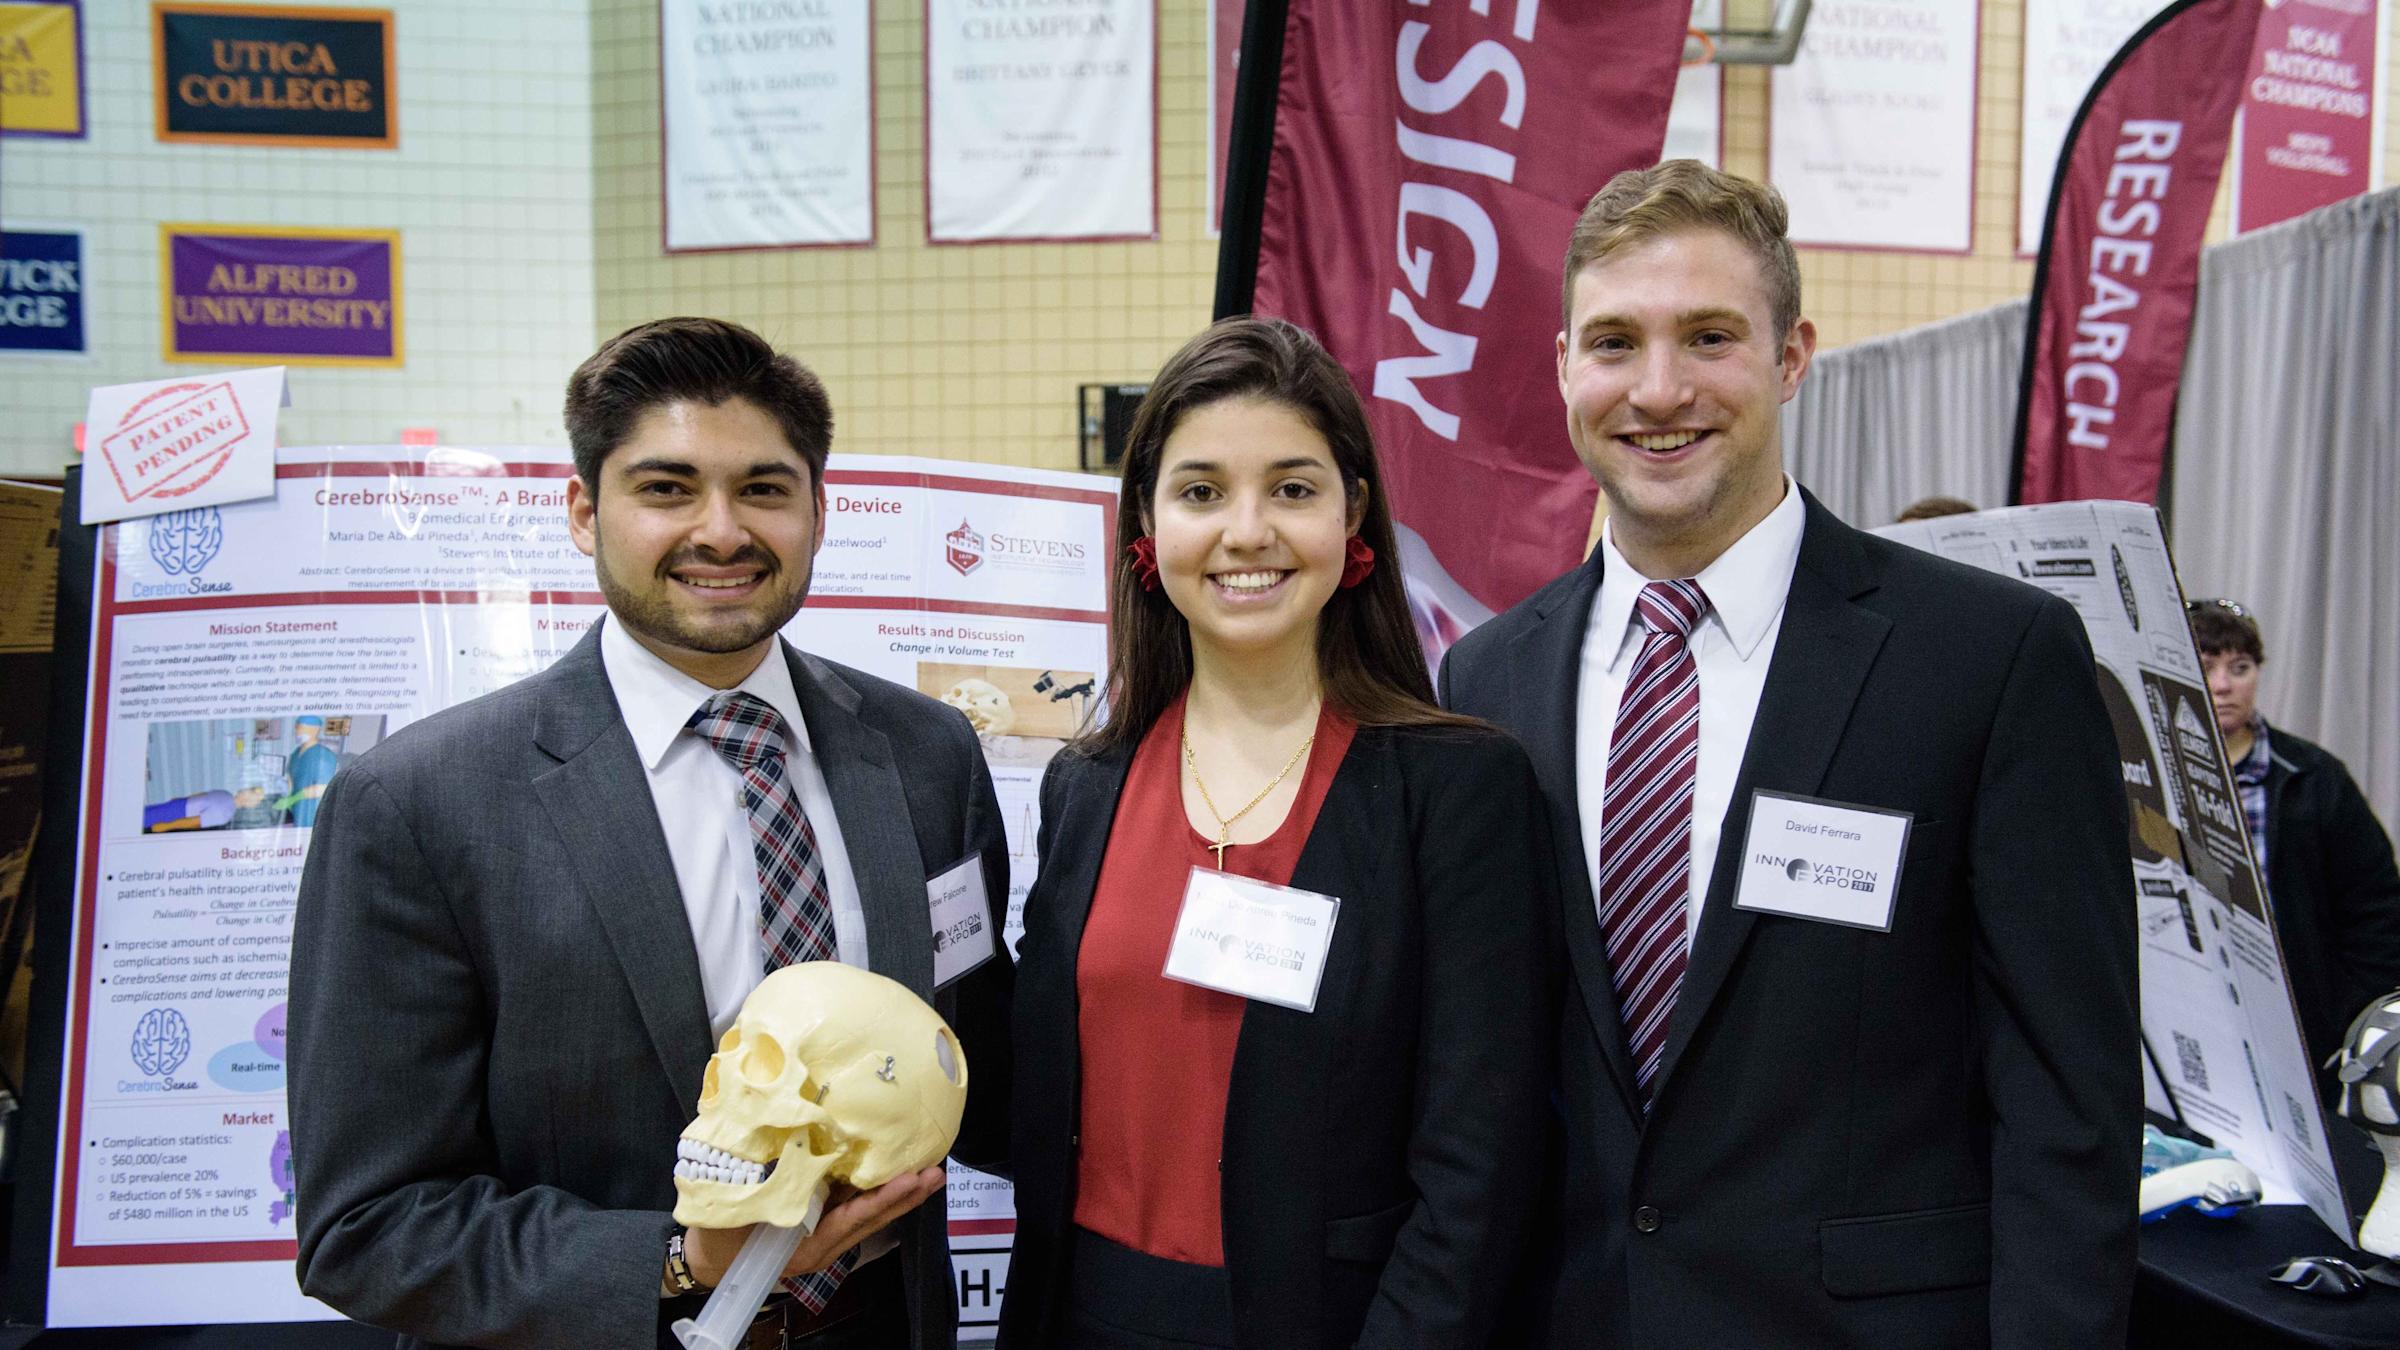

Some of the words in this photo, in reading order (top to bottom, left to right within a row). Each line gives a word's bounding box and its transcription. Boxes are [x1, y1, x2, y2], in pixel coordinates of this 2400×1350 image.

[961, 14, 1116, 41] CHAMPION
[693, 26, 838, 57] CHAMPION
[212, 40, 336, 75] UTICA
[2265, 51, 2361, 89] NATIONAL
[178, 75, 373, 112] COLLEGE
[2252, 76, 2369, 118] CHAMPIONS
[207, 262, 357, 295] ALFRED
[2064, 120, 2183, 450] RESEARCH
[174, 297, 392, 330] UNIVERSITY
[127, 397, 221, 452] PATENT
[135, 414, 235, 477] PENDING
[496, 490, 509, 505] A
[836, 497, 902, 513] Device
[408, 512, 485, 524] Bomedical
[329, 531, 364, 541] Maria
[368, 531, 384, 541] De
[547, 548, 561, 558] of
[991, 533, 1086, 559] STEVENS
[890, 574, 912, 582] time
[132, 577, 233, 598] CerebroSense
[809, 584, 864, 593] mplications
[209, 623, 261, 636] Mission
[265, 621, 338, 634] Statement
[537, 618, 592, 631] Materia
[878, 624, 926, 636] Results
[930, 627, 954, 638] and
[958, 627, 1025, 643] Discussion
[161, 643, 183, 653] open
[319, 636, 336, 644] and
[889, 642, 931, 654] Change
[934, 644, 944, 654] in
[948, 645, 989, 657] Volume
[993, 648, 1015, 658] Test
[155, 655, 191, 665] cerebral
[192, 653, 237, 664] pulsatility
[290, 649, 335, 658] determine
[336, 649, 356, 657] how
[357, 649, 372, 657] the
[374, 648, 396, 657] brain
[279, 663, 293, 671] the
[295, 662, 356, 671] measurement
[368, 662, 398, 670] limited
[120, 684, 165, 695] qualitative
[167, 682, 209, 691] technique
[210, 680, 235, 688] which
[291, 676, 337, 685] inaccurate
[339, 675, 407, 684] determinations
[161, 694, 218, 704] complications
[249, 691, 266, 699] and
[290, 689, 304, 697] the
[344, 688, 401, 698] Recognizing
[402, 688, 417, 696] the
[304, 702, 342, 711] solution
[356, 702, 372, 710] this
[2121, 758, 2152, 786] oard
[1785, 820, 1817, 835] David
[1820, 825, 1861, 841] Ferrara
[221, 845, 303, 861] Background
[118, 869, 165, 882] Cerebral
[168, 867, 222, 882] pulsatility
[225, 867, 233, 877] is
[237, 866, 263, 877] used
[169, 885, 203, 897] health
[206, 882, 297, 896] intraoperatively
[943, 885, 967, 902] Falcone
[1852, 881, 1875, 893] 2017
[210, 900, 245, 911] Change
[260, 898, 296, 908] Cerebra
[152, 909, 198, 920] Pulsatility
[216, 916, 250, 926] Change
[265, 914, 286, 925] Cuff
[114, 939, 168, 952] Imprecise
[171, 937, 214, 948] amount
[218, 935, 229, 946] of
[233, 936, 291, 949] compensa
[113, 953, 190, 968] complications
[193, 953, 218, 964] such
[221, 954, 234, 963] as
[112, 972, 187, 986] CerebroSense
[190, 971, 217, 982] aims
[220, 971, 232, 981] at
[235, 969, 288, 981] decreasin
[111, 988, 187, 1004] complications
[190, 987, 212, 999] and
[215, 986, 264, 1000] lowering
[231, 1062, 280, 1072] Real-time
[117, 1077, 199, 1093] CerebroSense
[222, 1113, 275, 1126] Market
[102, 1137, 176, 1151] Complication
[178, 1135, 233, 1146] statistics:
[111, 1154, 187, 1167] $60,000/case
[110, 1173, 127, 1185] US
[129, 1172, 191, 1186] prevalence
[194, 1170, 219, 1181] 20%
[958, 1180, 970, 1191] of
[973, 1180, 1013, 1191] craniot
[109, 1189, 167, 1202] Reduction
[170, 1188, 182, 1200] of
[185, 1188, 202, 1199] 5%
[215, 1187, 258, 1200] savings
[948, 1197, 980, 1208] dards
[108, 1209, 121, 1221] of
[123, 1207, 151, 1220] $480
[154, 1206, 193, 1219] million
[196, 1207, 208, 1218] in
[210, 1206, 229, 1217] the
[232, 1205, 249, 1217] US
